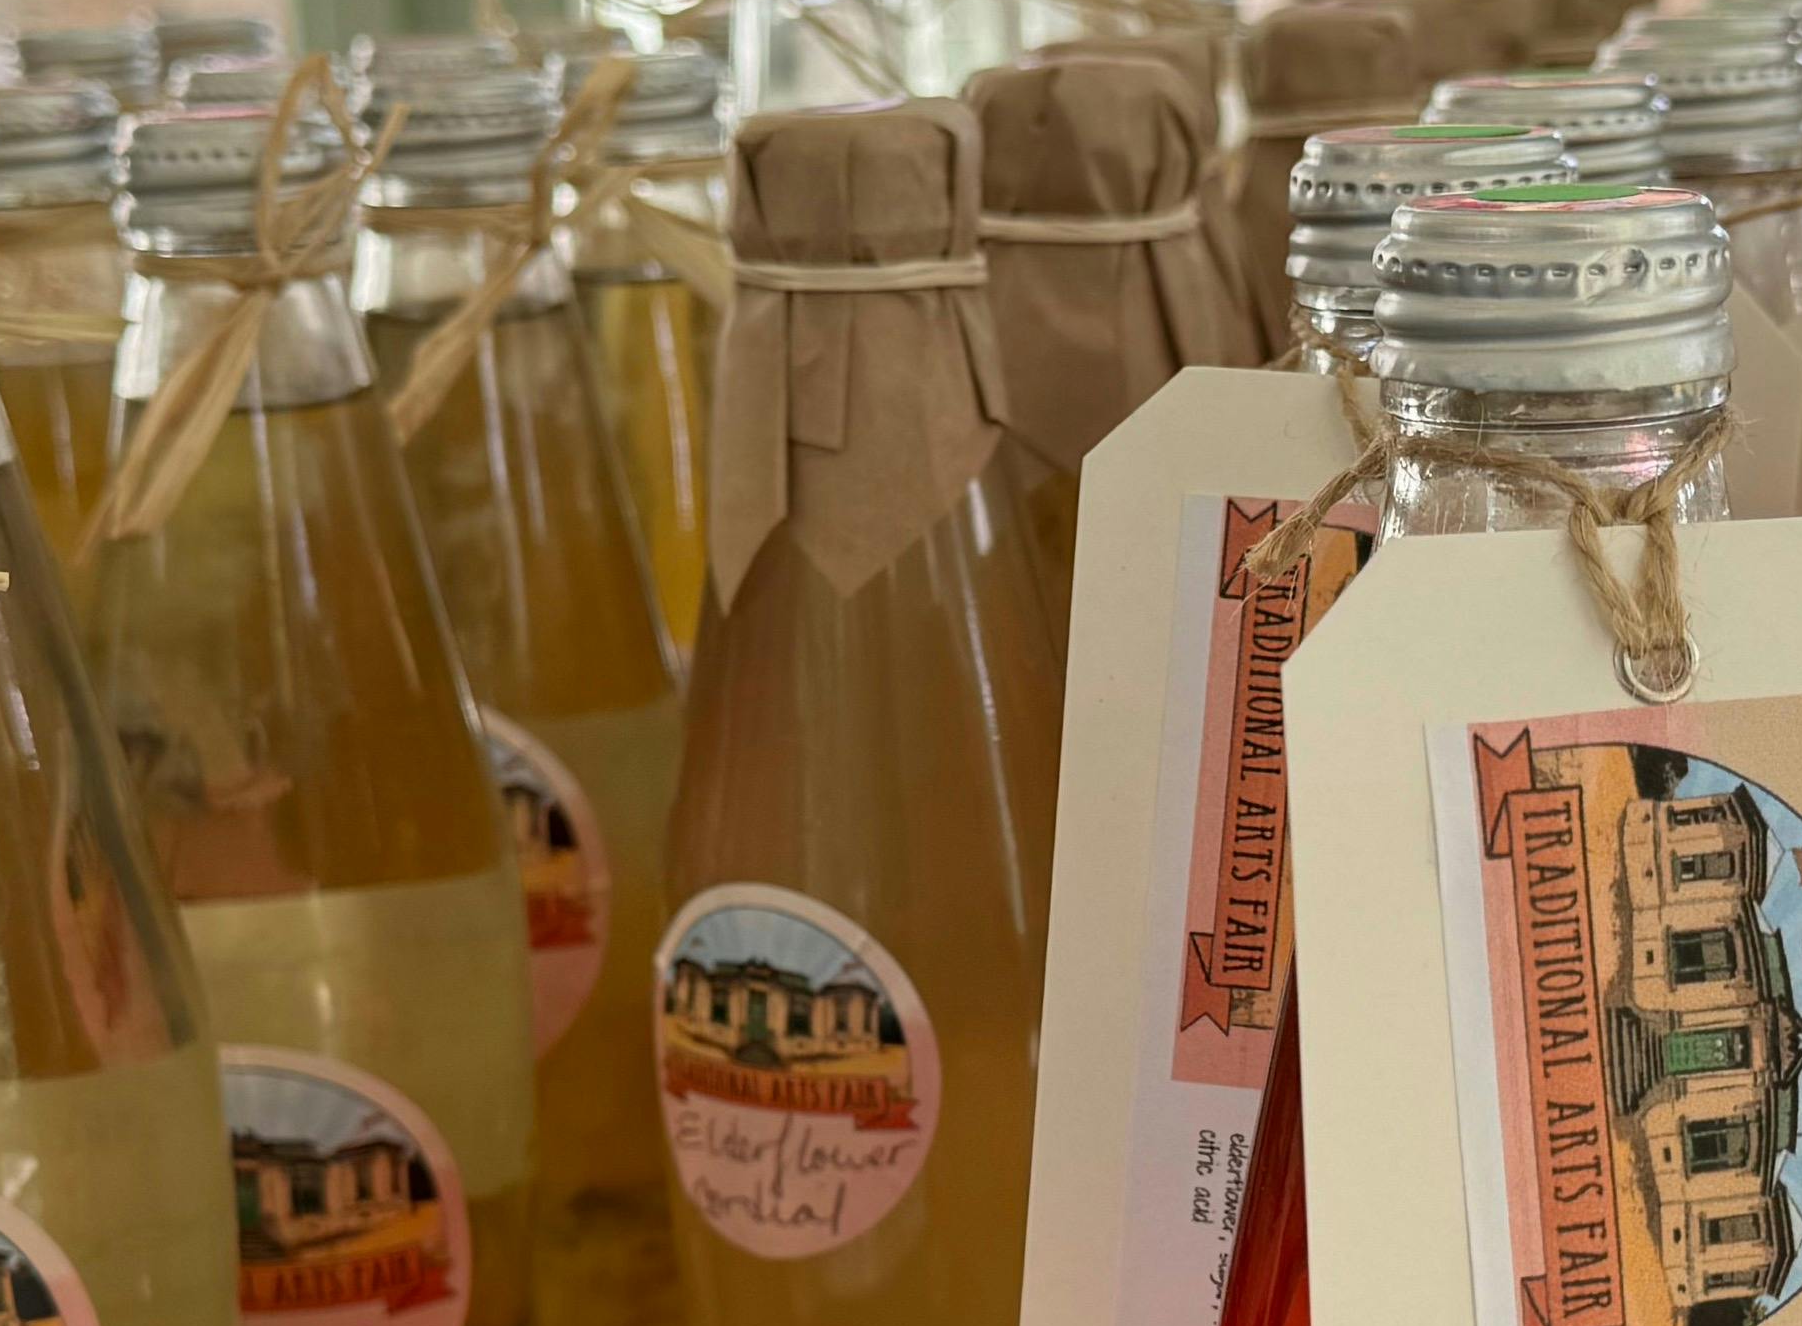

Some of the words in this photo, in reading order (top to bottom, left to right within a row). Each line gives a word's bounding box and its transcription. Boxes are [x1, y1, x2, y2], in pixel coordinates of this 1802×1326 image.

[1235, 797, 1278, 883] ARTS
[1222, 897, 1268, 974] FAIR
[1522, 800, 1591, 1078] TRADITIONAL
[1197, 1129, 1221, 1175] citric
[1547, 1099, 1605, 1205] ARTS
[1193, 1186, 1213, 1224] acid
[1555, 1219, 1613, 1320] FAIR
